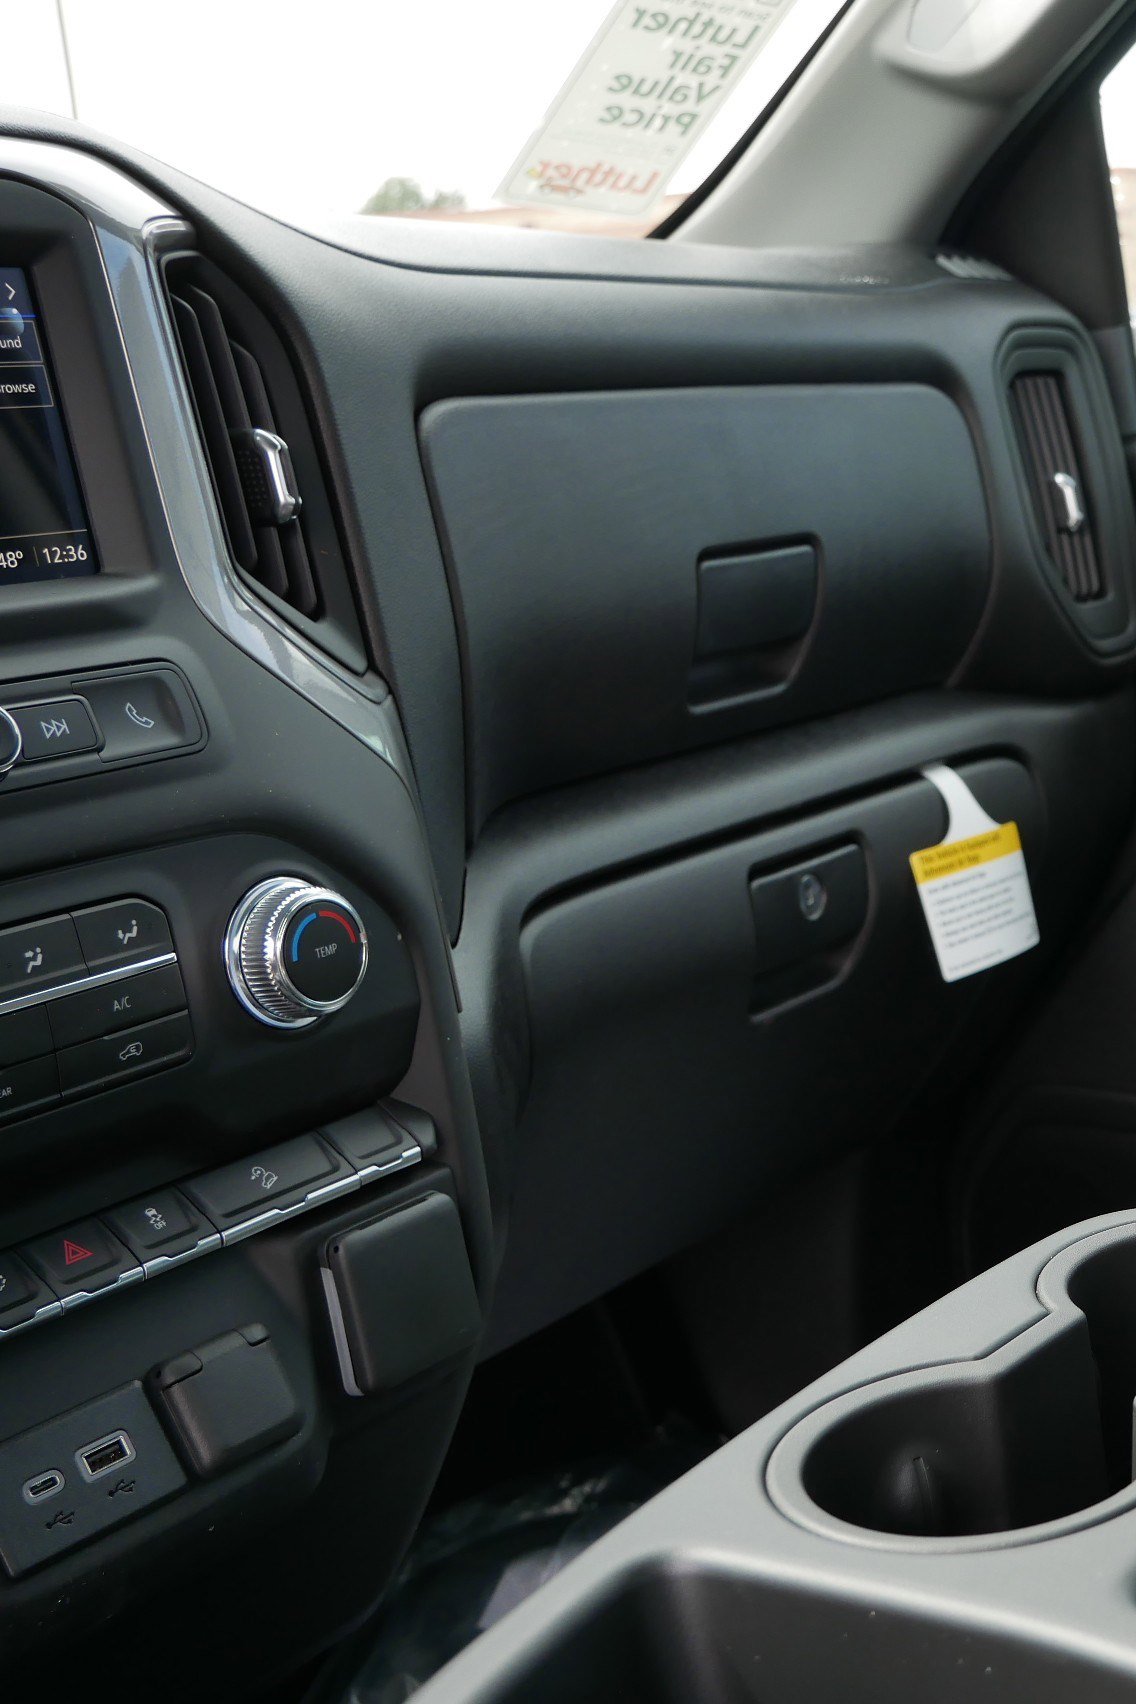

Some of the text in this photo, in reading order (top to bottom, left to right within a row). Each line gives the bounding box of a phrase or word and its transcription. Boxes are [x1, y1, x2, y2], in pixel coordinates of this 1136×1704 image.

[43, 544, 88, 564] 12:36
[315, 943, 337, 958] TEMP
[113, 996, 132, 1011] A/C
